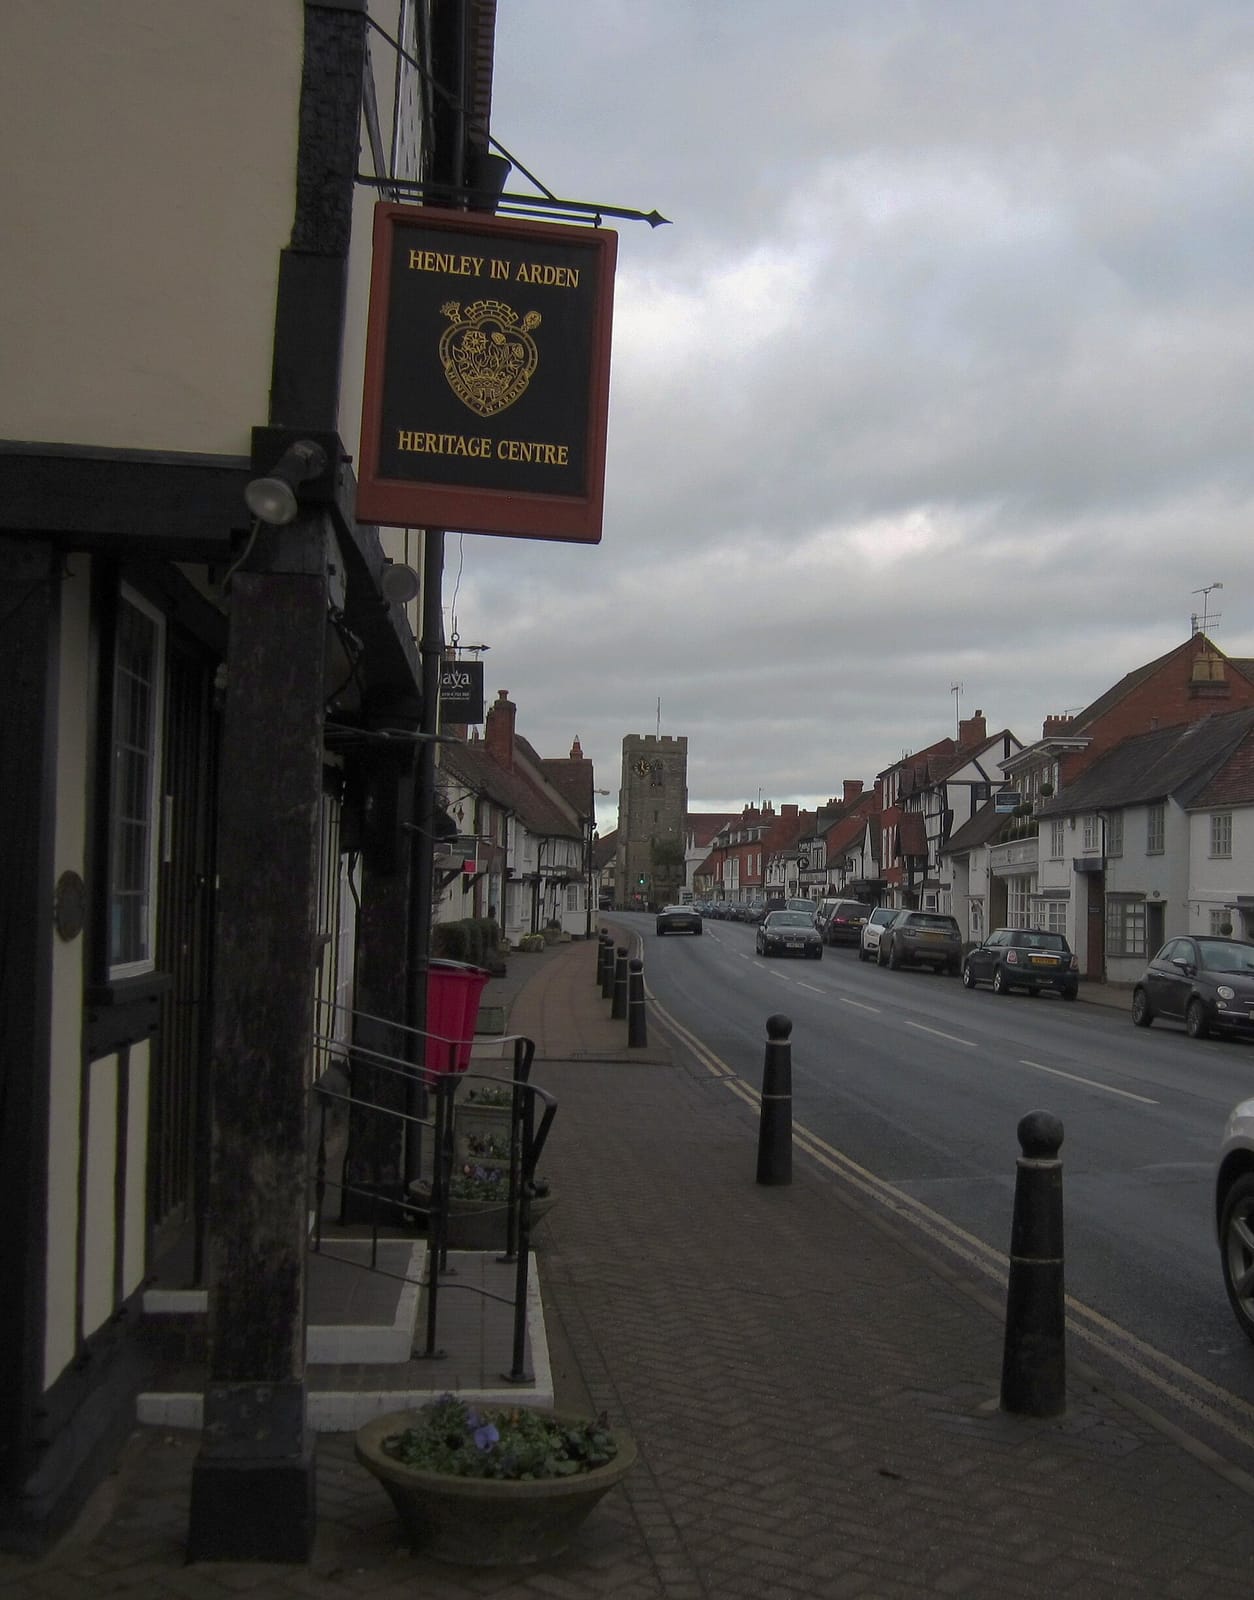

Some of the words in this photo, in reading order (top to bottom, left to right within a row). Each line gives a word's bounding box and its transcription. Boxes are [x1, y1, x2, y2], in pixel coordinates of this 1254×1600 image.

[409, 249, 484, 277] HENLEY
[490, 259, 511, 281] IN
[515, 262, 580, 289] ARDEN
[398, 430, 492, 458] HERITAGE
[497, 440, 569, 465] CENTRE
